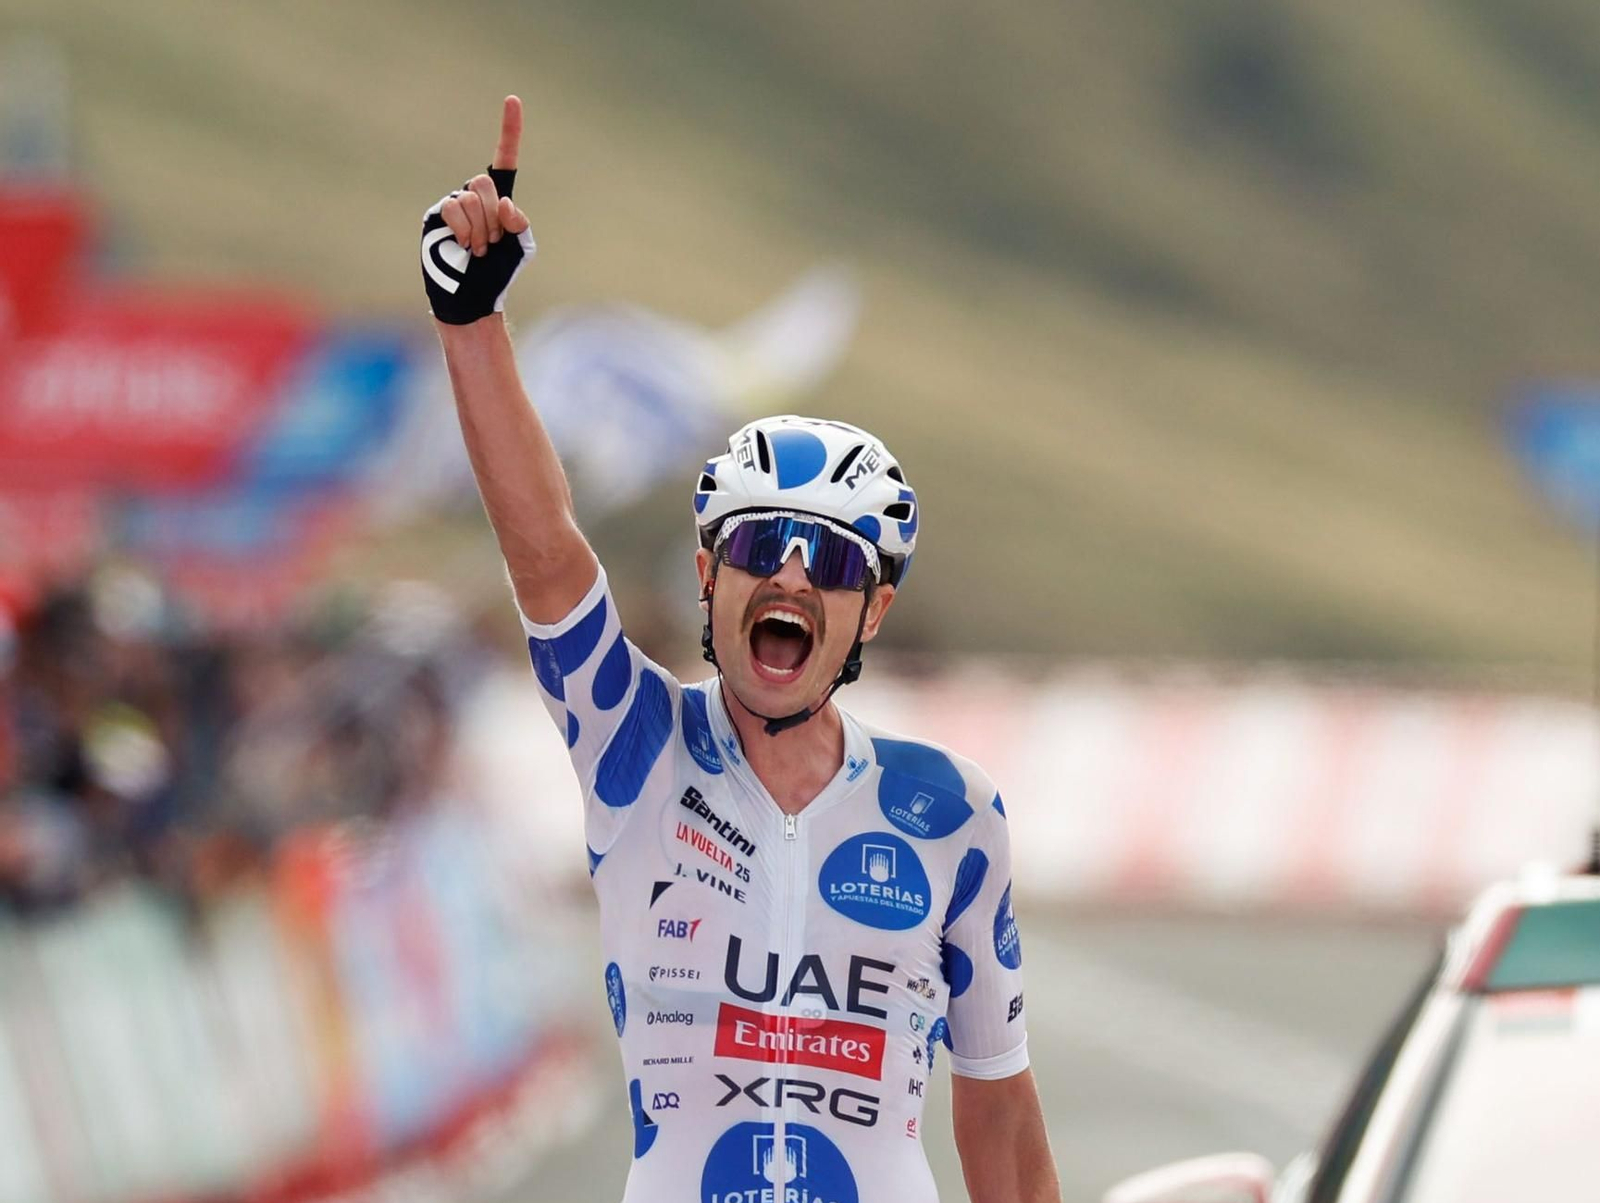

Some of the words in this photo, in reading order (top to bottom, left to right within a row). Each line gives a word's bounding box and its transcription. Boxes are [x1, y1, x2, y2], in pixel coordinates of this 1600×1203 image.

[845, 443, 882, 490] MET
[680, 785, 756, 857] Santini
[676, 821, 689, 843] LA
[691, 828, 733, 872] VUELTA
[734, 862, 751, 883] 25
[674, 862, 687, 878] J.
[696, 868, 747, 904] VINE
[829, 882, 925, 907] LOTERÍAS
[660, 967, 701, 980] PISSEI
[723, 933, 896, 1020] UAE
[655, 1010, 694, 1026] Analog
[734, 1019, 871, 1063] Emirates
[652, 1092, 680, 1111] ADQ
[714, 1073, 881, 1128] XRG
